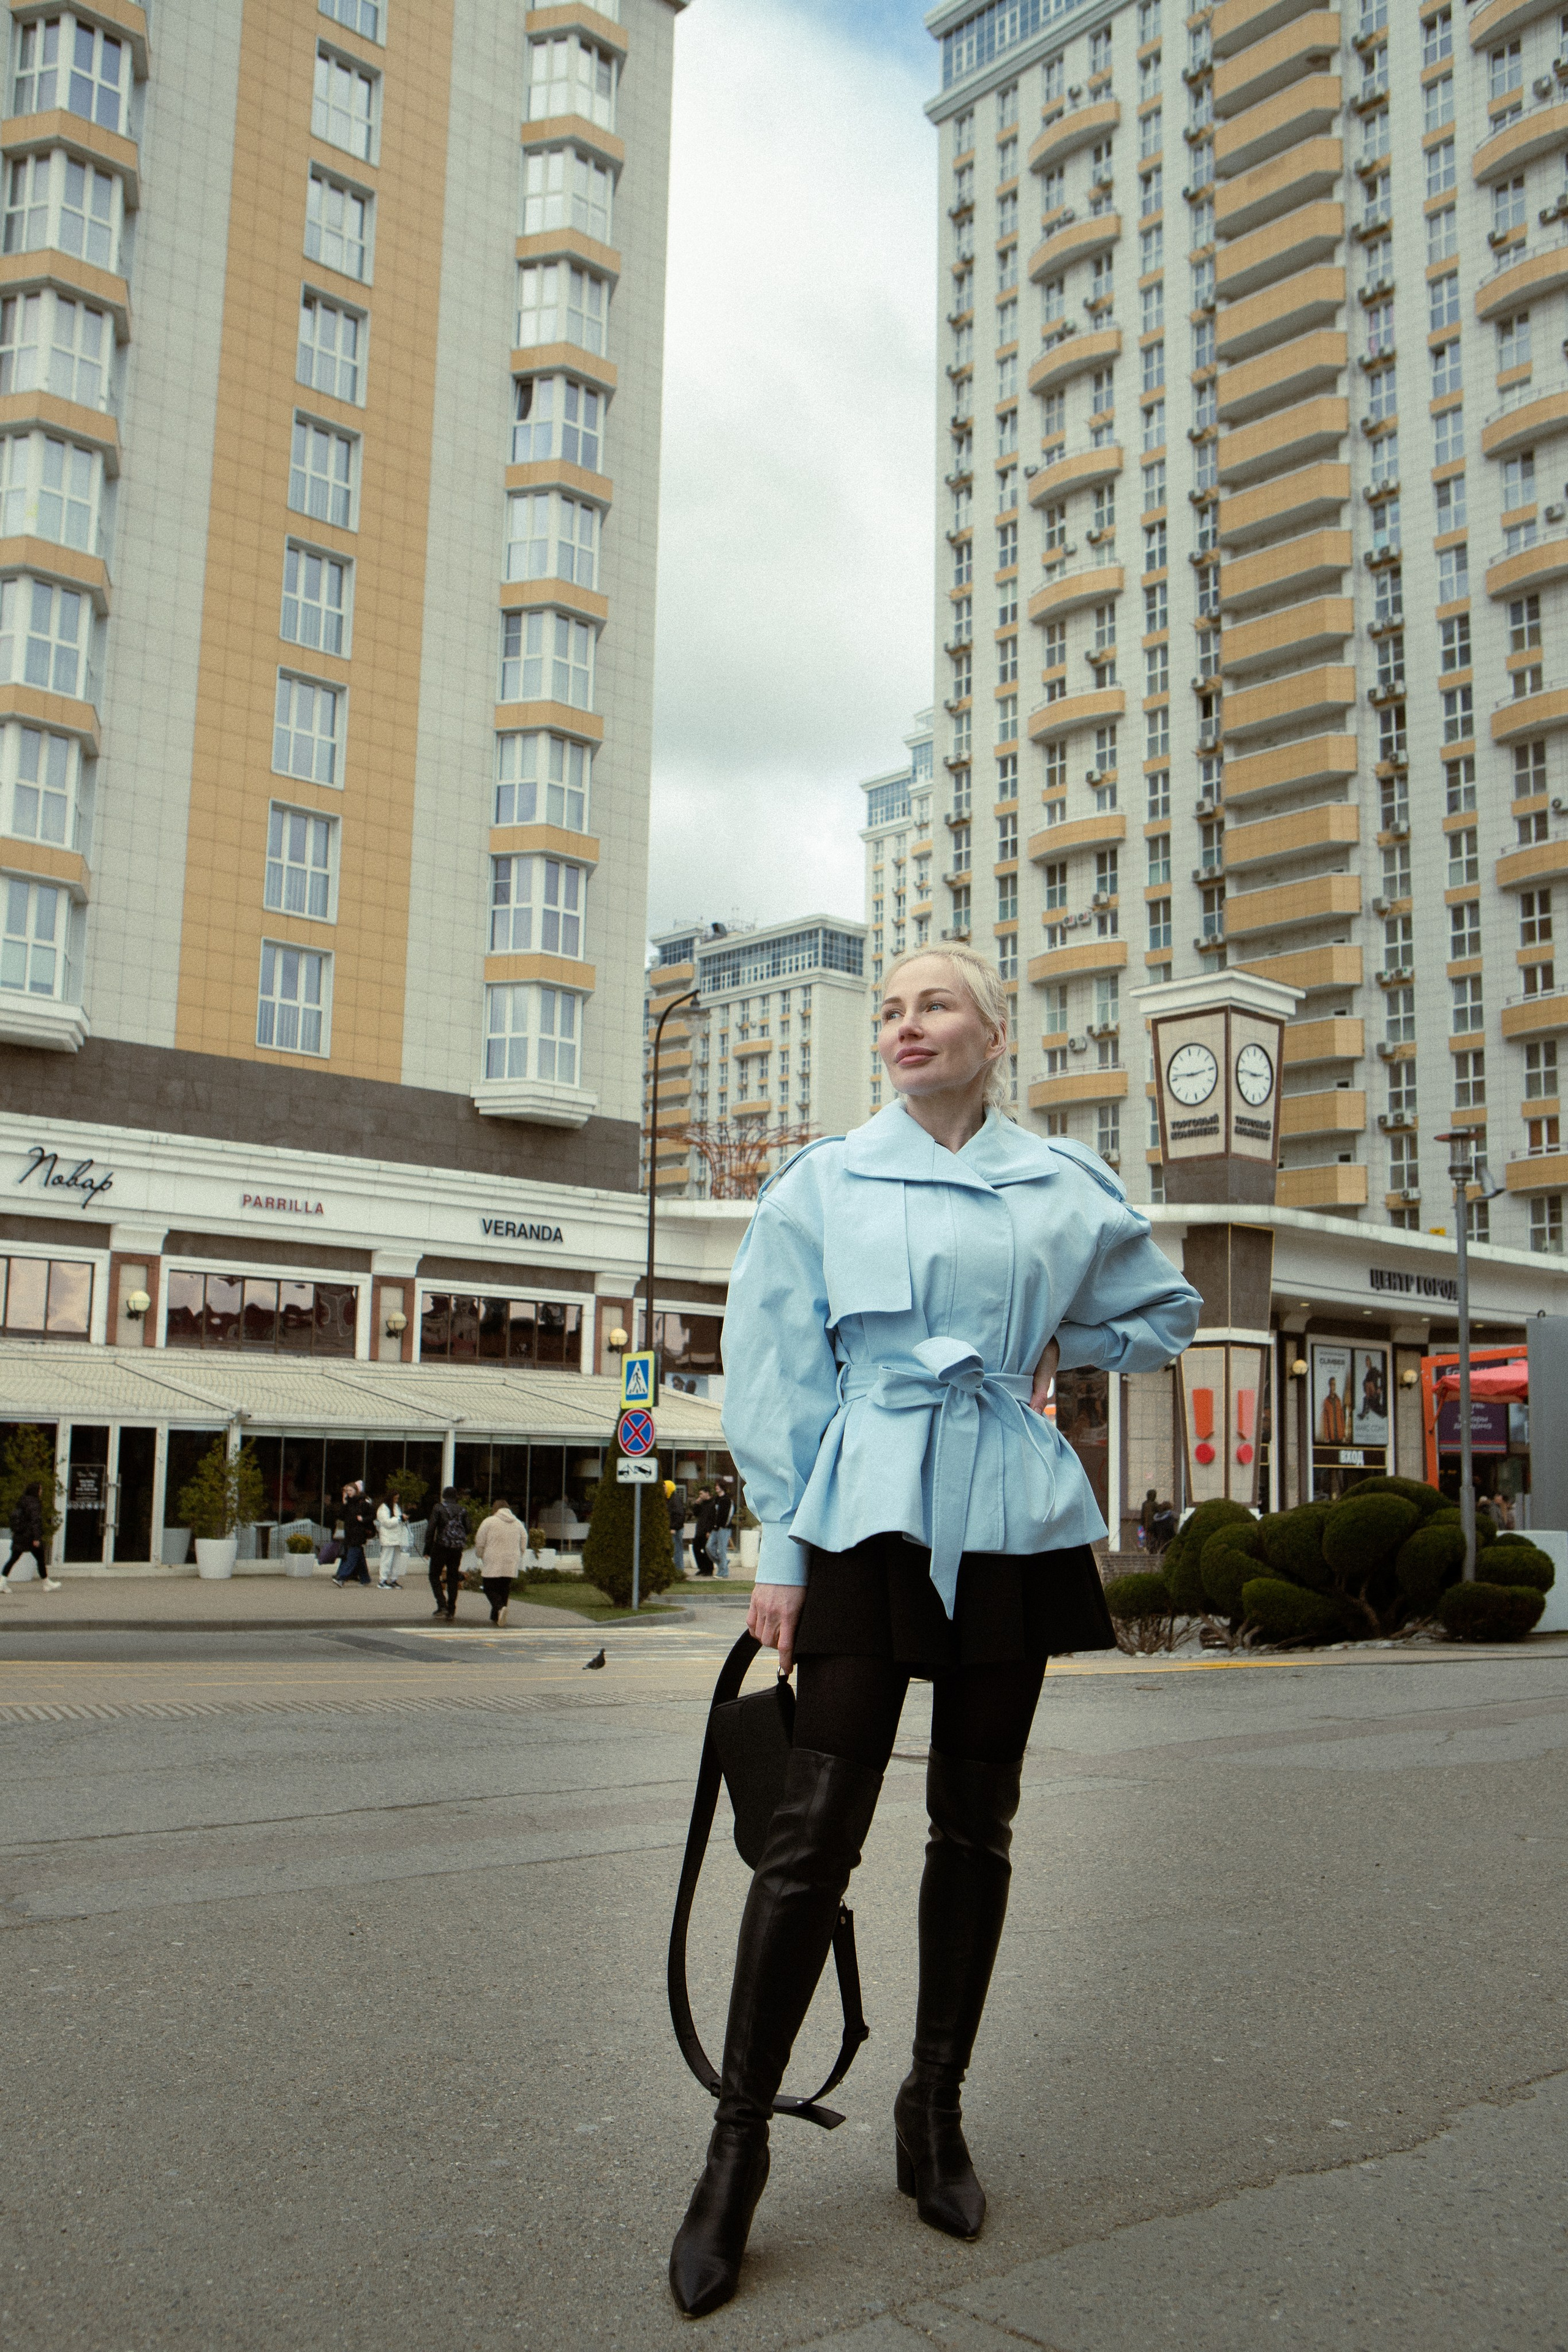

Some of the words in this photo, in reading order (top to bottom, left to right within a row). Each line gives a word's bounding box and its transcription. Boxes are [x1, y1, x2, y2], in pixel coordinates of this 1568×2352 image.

[243, 1194, 324, 1214] PARRILLA
[481, 1218, 564, 1243] VERANDA
[1370, 1268, 1414, 1292] ЦЕНТР
[1416, 1275, 1458, 1301] ГОРОД
[1339, 1450, 1364, 1466] ВХОД
